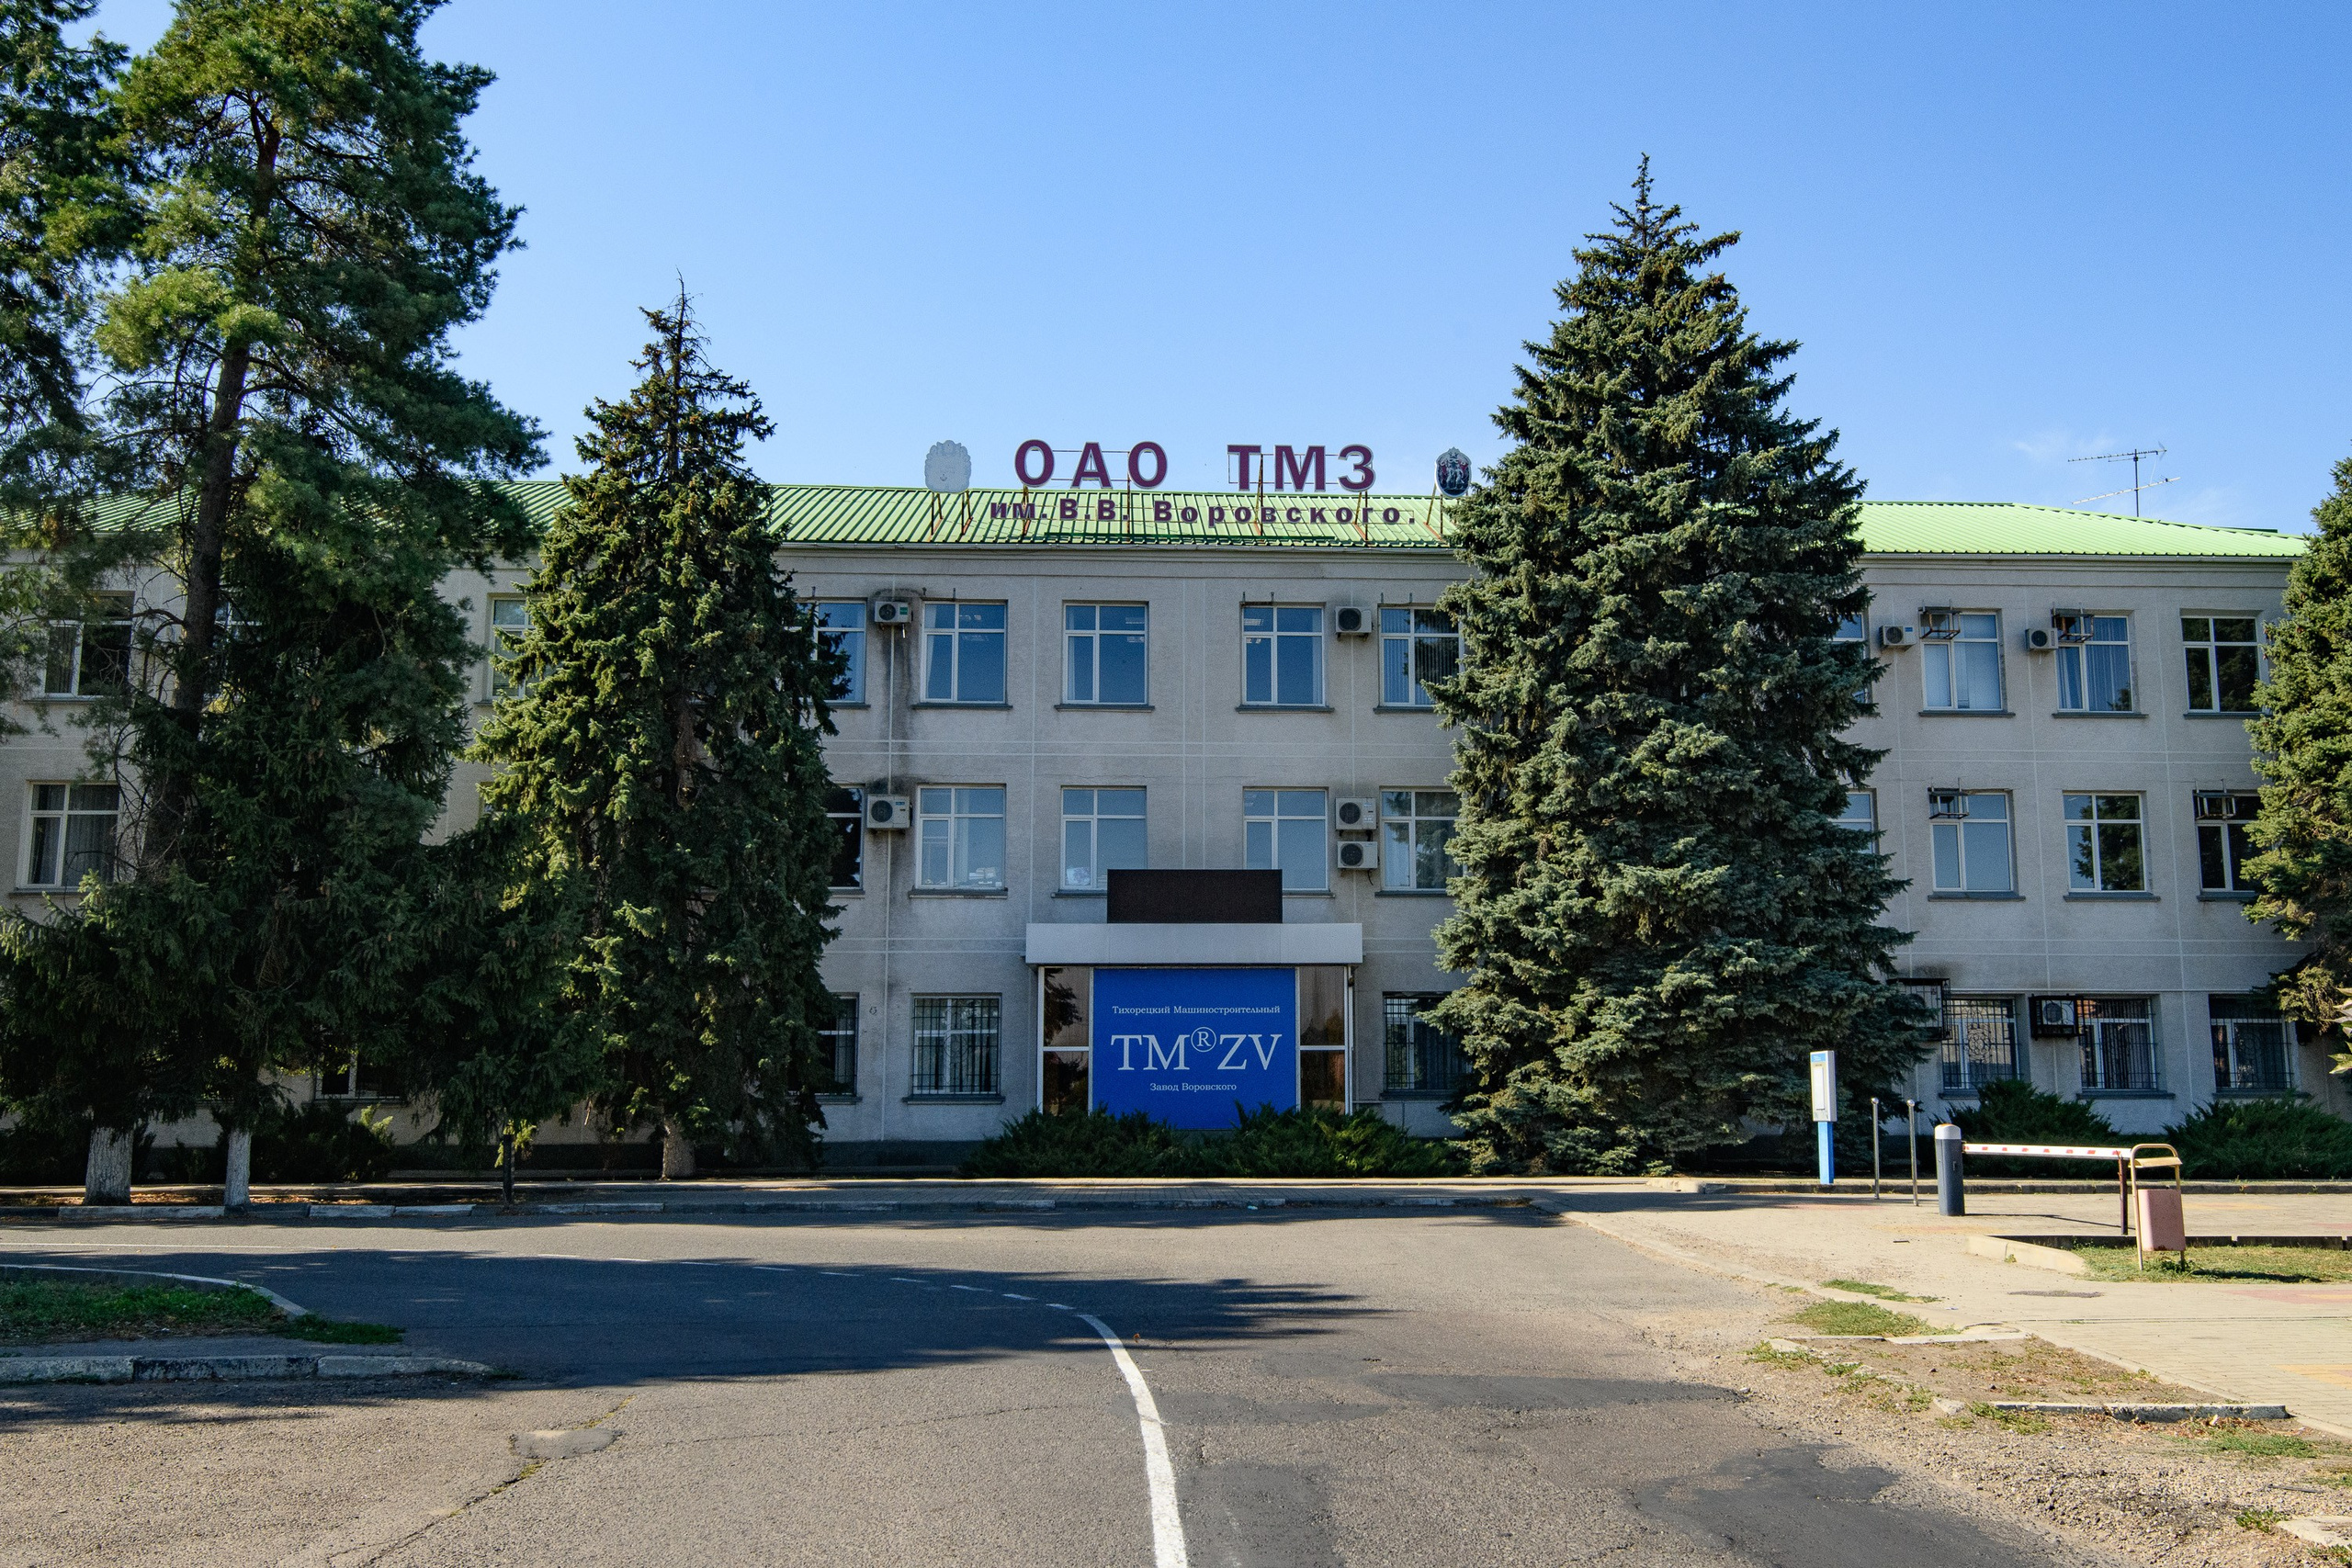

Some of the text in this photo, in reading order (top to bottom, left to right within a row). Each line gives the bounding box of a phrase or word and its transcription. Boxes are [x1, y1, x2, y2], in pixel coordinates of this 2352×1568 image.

[1014, 439, 1376, 492] ОАО ТМЗ
[990, 502, 1048, 520] им.
[1059, 498, 1129, 521] В.В.
[1112, 1006, 1281, 1015] Тихорецкий Машиностроительный
[1149, 1082, 1237, 1093] Завод Воровского
